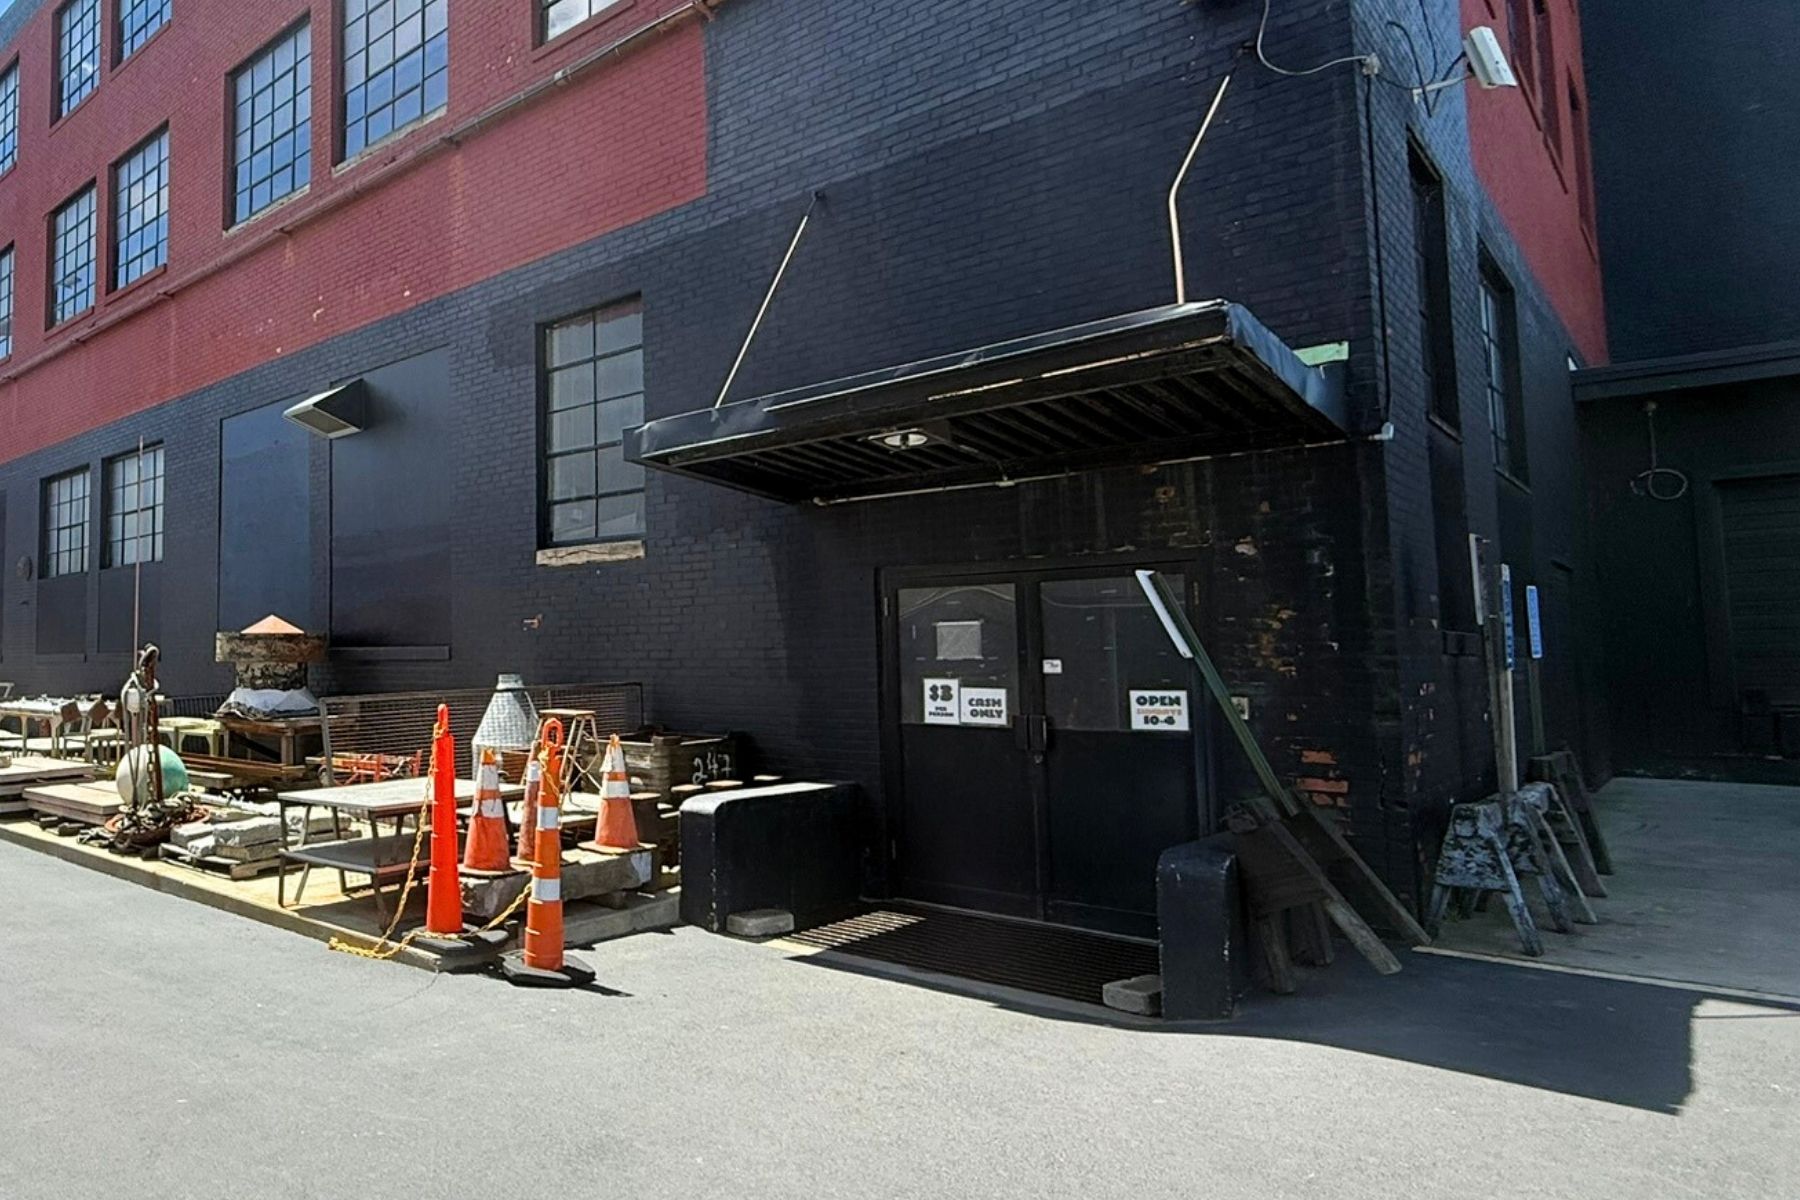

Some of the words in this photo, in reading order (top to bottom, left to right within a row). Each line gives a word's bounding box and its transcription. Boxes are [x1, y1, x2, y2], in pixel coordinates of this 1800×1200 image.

[968, 698, 1002, 707] CASH
[1136, 696, 1181, 706] OPEN
[970, 708, 1003, 718] ONLY
[692, 751, 732, 785] 247
